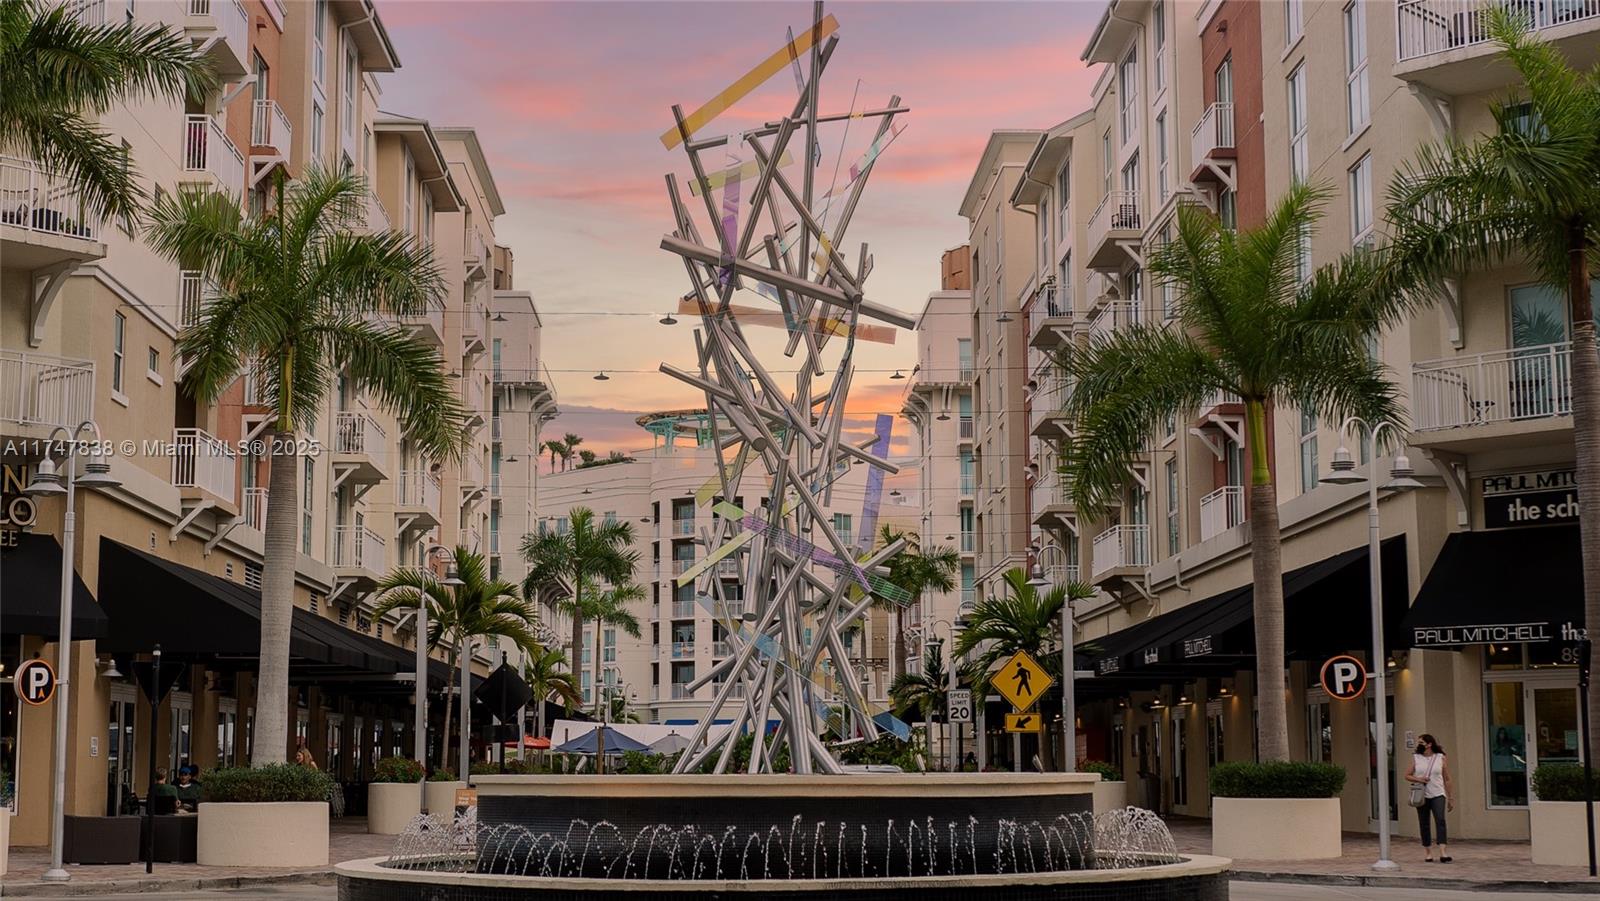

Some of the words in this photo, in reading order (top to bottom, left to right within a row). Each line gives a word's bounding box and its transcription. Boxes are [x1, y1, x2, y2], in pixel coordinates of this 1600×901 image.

[1483, 475, 1534, 493] PAUL
[1508, 498, 1541, 522] the
[1414, 630, 1461, 643] PAUL
[1463, 626, 1551, 641] MITCHELL
[29, 667, 49, 699] P
[1333, 662, 1357, 694] P
[950, 707, 969, 719] 20
